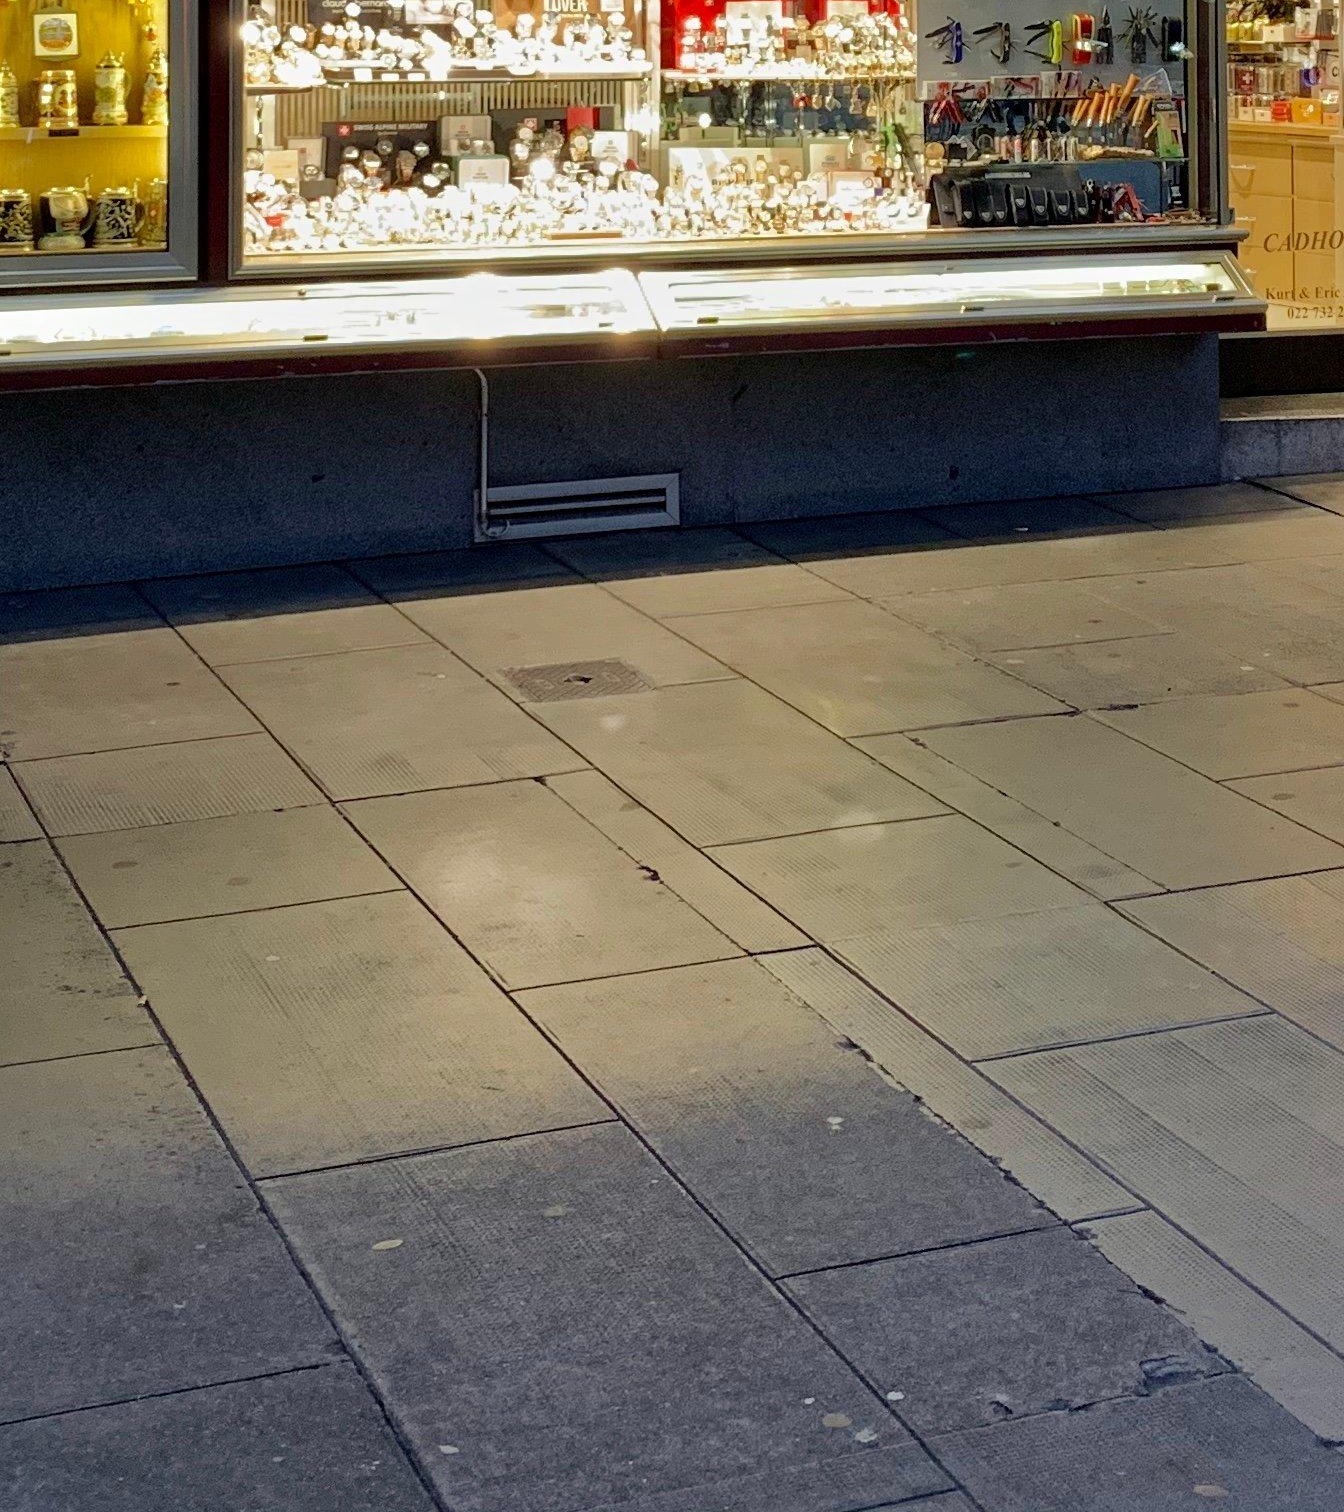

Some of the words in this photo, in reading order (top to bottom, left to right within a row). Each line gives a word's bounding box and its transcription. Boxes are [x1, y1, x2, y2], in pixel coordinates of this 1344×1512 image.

[1265, 287, 1294, 300] Kurt
[1299, 287, 1310, 299] &
[1315, 286, 1339, 299] Eric
[1287, 307, 1308, 319] 022
[1313, 306, 1333, 318] 732
